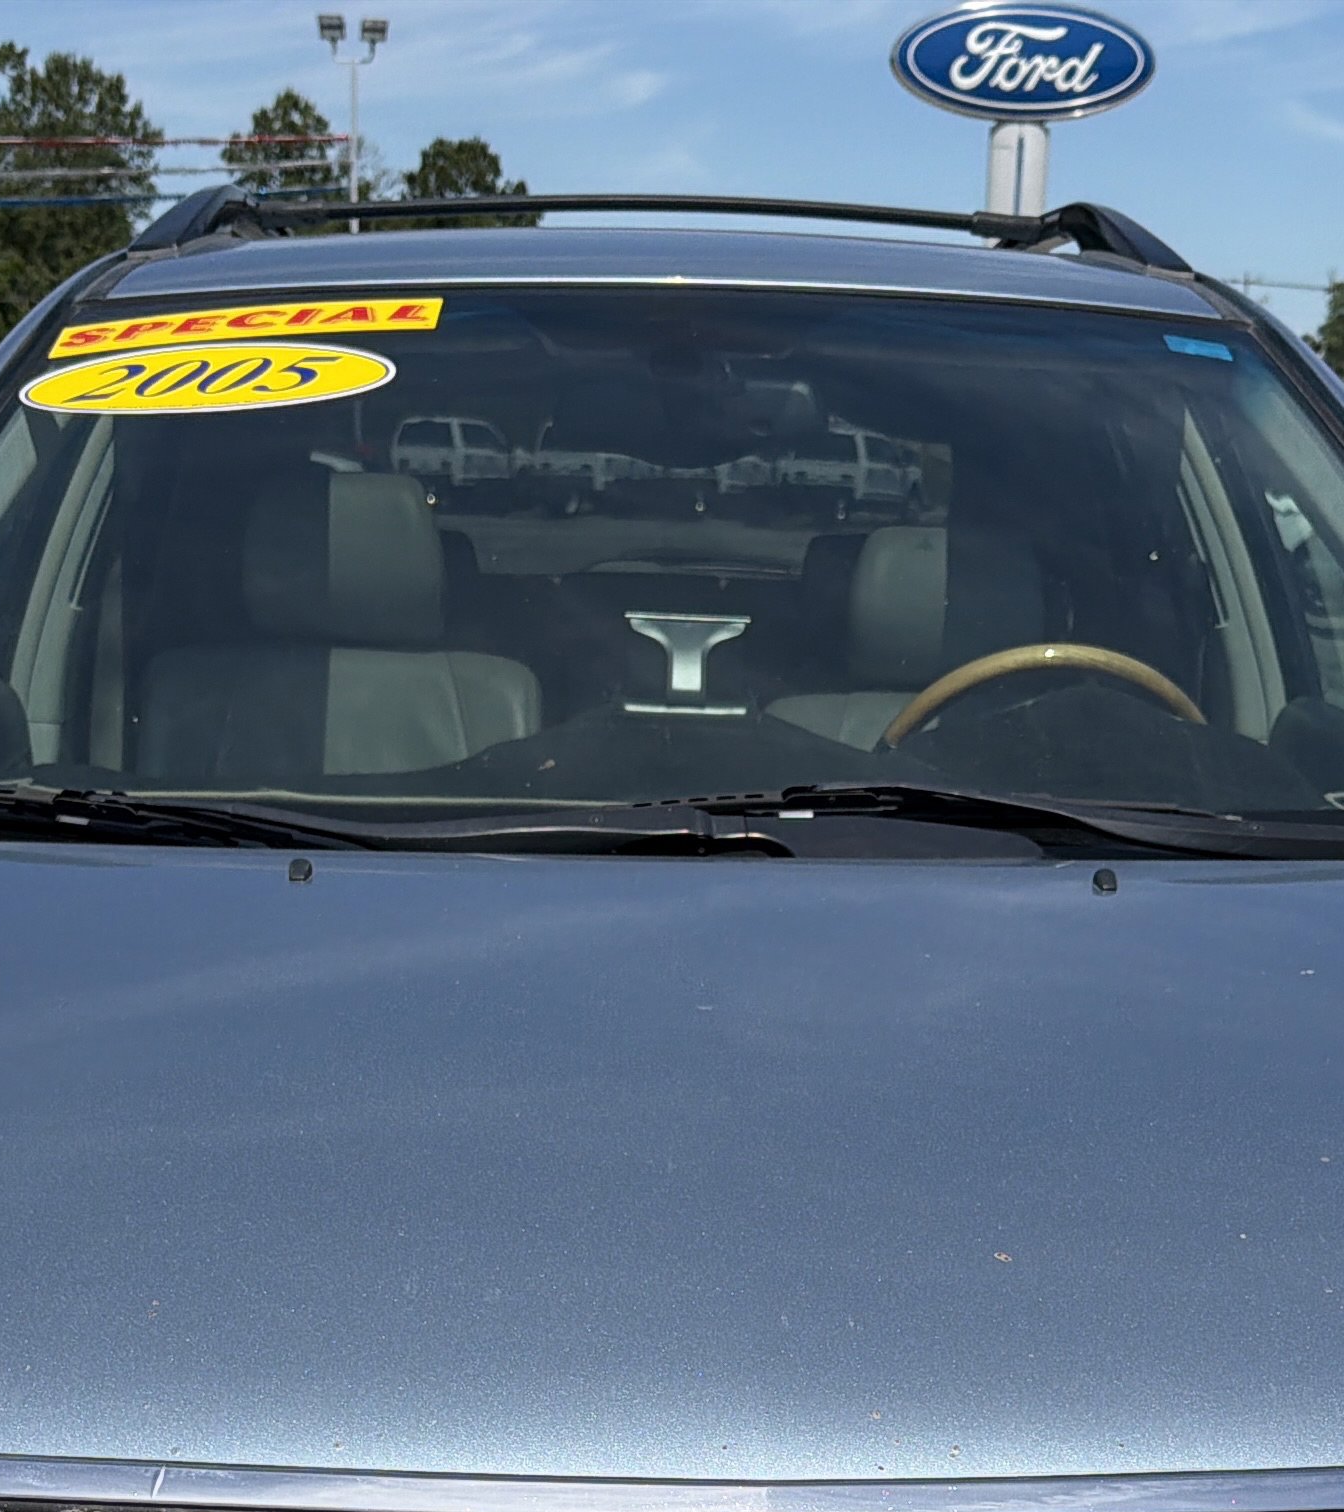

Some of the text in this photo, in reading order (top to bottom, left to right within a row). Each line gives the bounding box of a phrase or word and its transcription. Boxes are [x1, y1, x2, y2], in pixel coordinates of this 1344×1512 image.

[949, 21, 1105, 93] Ford
[60, 304, 431, 348] SPECIAL
[60, 356, 346, 404] 2005
